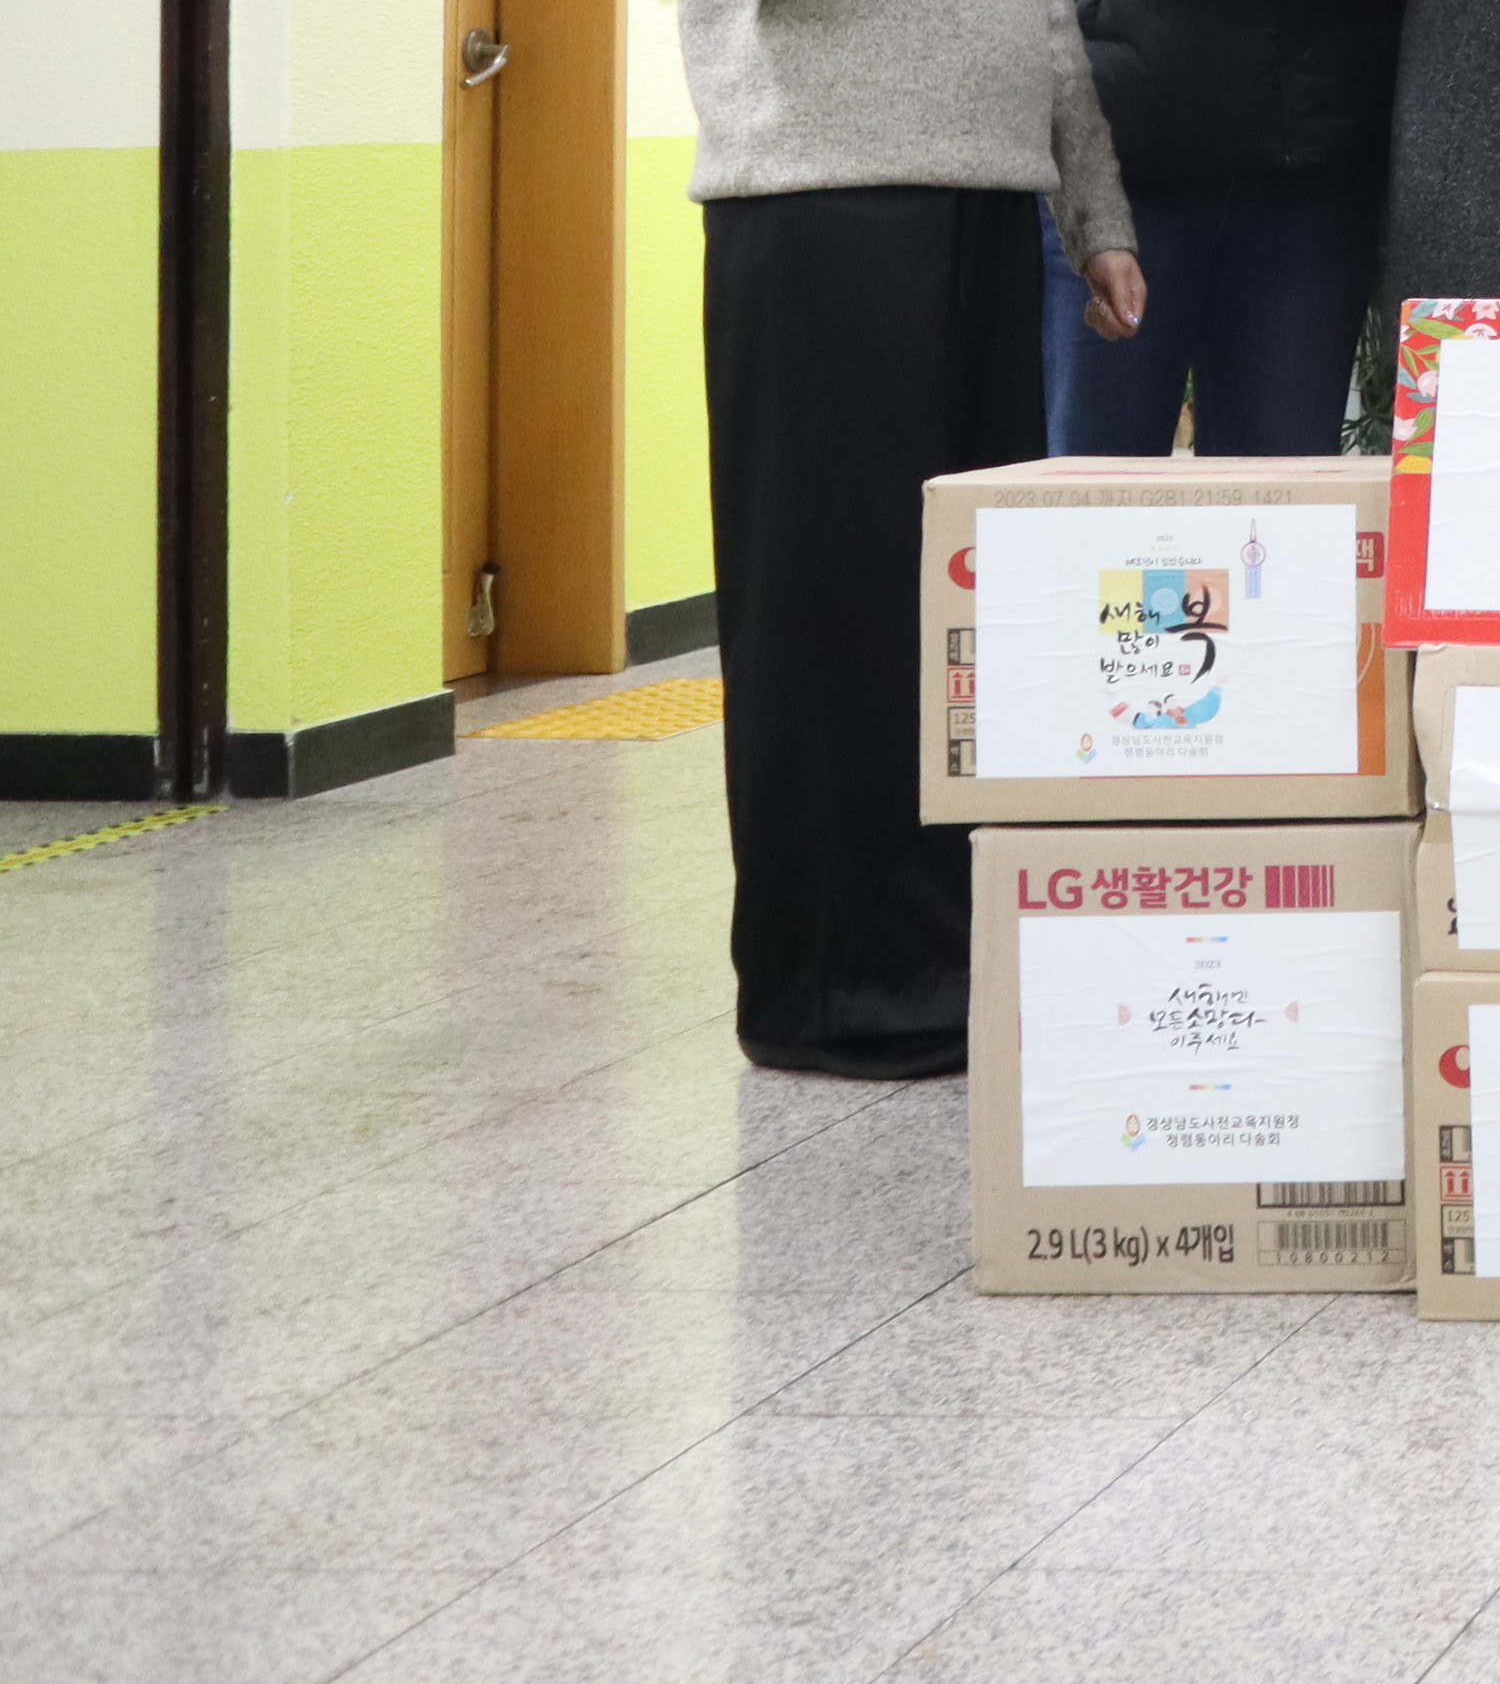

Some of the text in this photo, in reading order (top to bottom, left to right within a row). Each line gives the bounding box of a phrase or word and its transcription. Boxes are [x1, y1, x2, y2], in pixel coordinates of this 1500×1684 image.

[994, 490, 1091, 508] 2023.07.04
[1098, 489, 1132, 507] 까지
[1194, 489, 1243, 506] 21:59
[1253, 489, 1292, 505] 1421
[1099, 583, 1229, 685] 새해 복
[1117, 629, 1160, 655] 많이
[1100, 656, 1174, 684] 받으세요
[1018, 867, 1253, 910] LG 생활건강
[1194, 959, 1222, 970] 2023
[1147, 1115, 1300, 1132] 경상남도사천교육지원청
[1166, 1133, 1281, 1148] 청렴동아리 다솜회
[1114, 1225, 1149, 1266] kg)
[1175, 1224, 1235, 1263] 4개입
[1274, 1251, 1391, 1264] 10800212
